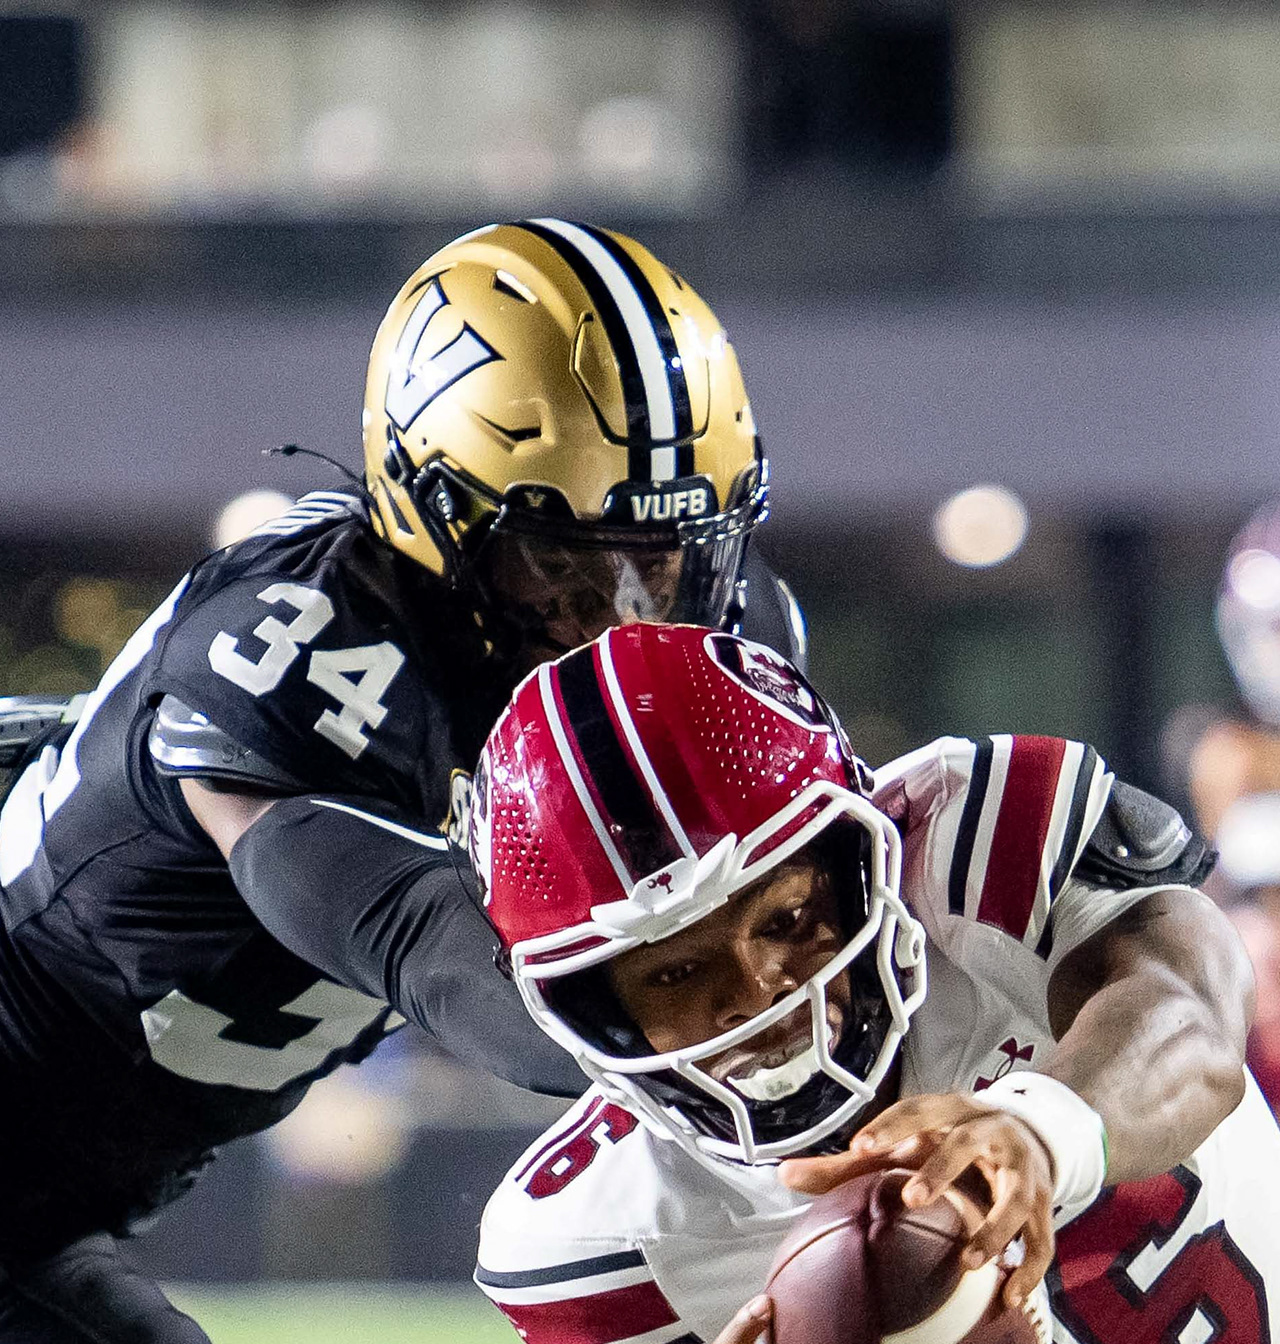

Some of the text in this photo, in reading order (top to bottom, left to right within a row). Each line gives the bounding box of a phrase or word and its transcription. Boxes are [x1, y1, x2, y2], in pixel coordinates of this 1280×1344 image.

[630, 488, 707, 522] VUFB
[207, 582, 406, 759] 34
[514, 1094, 640, 1199] 16
